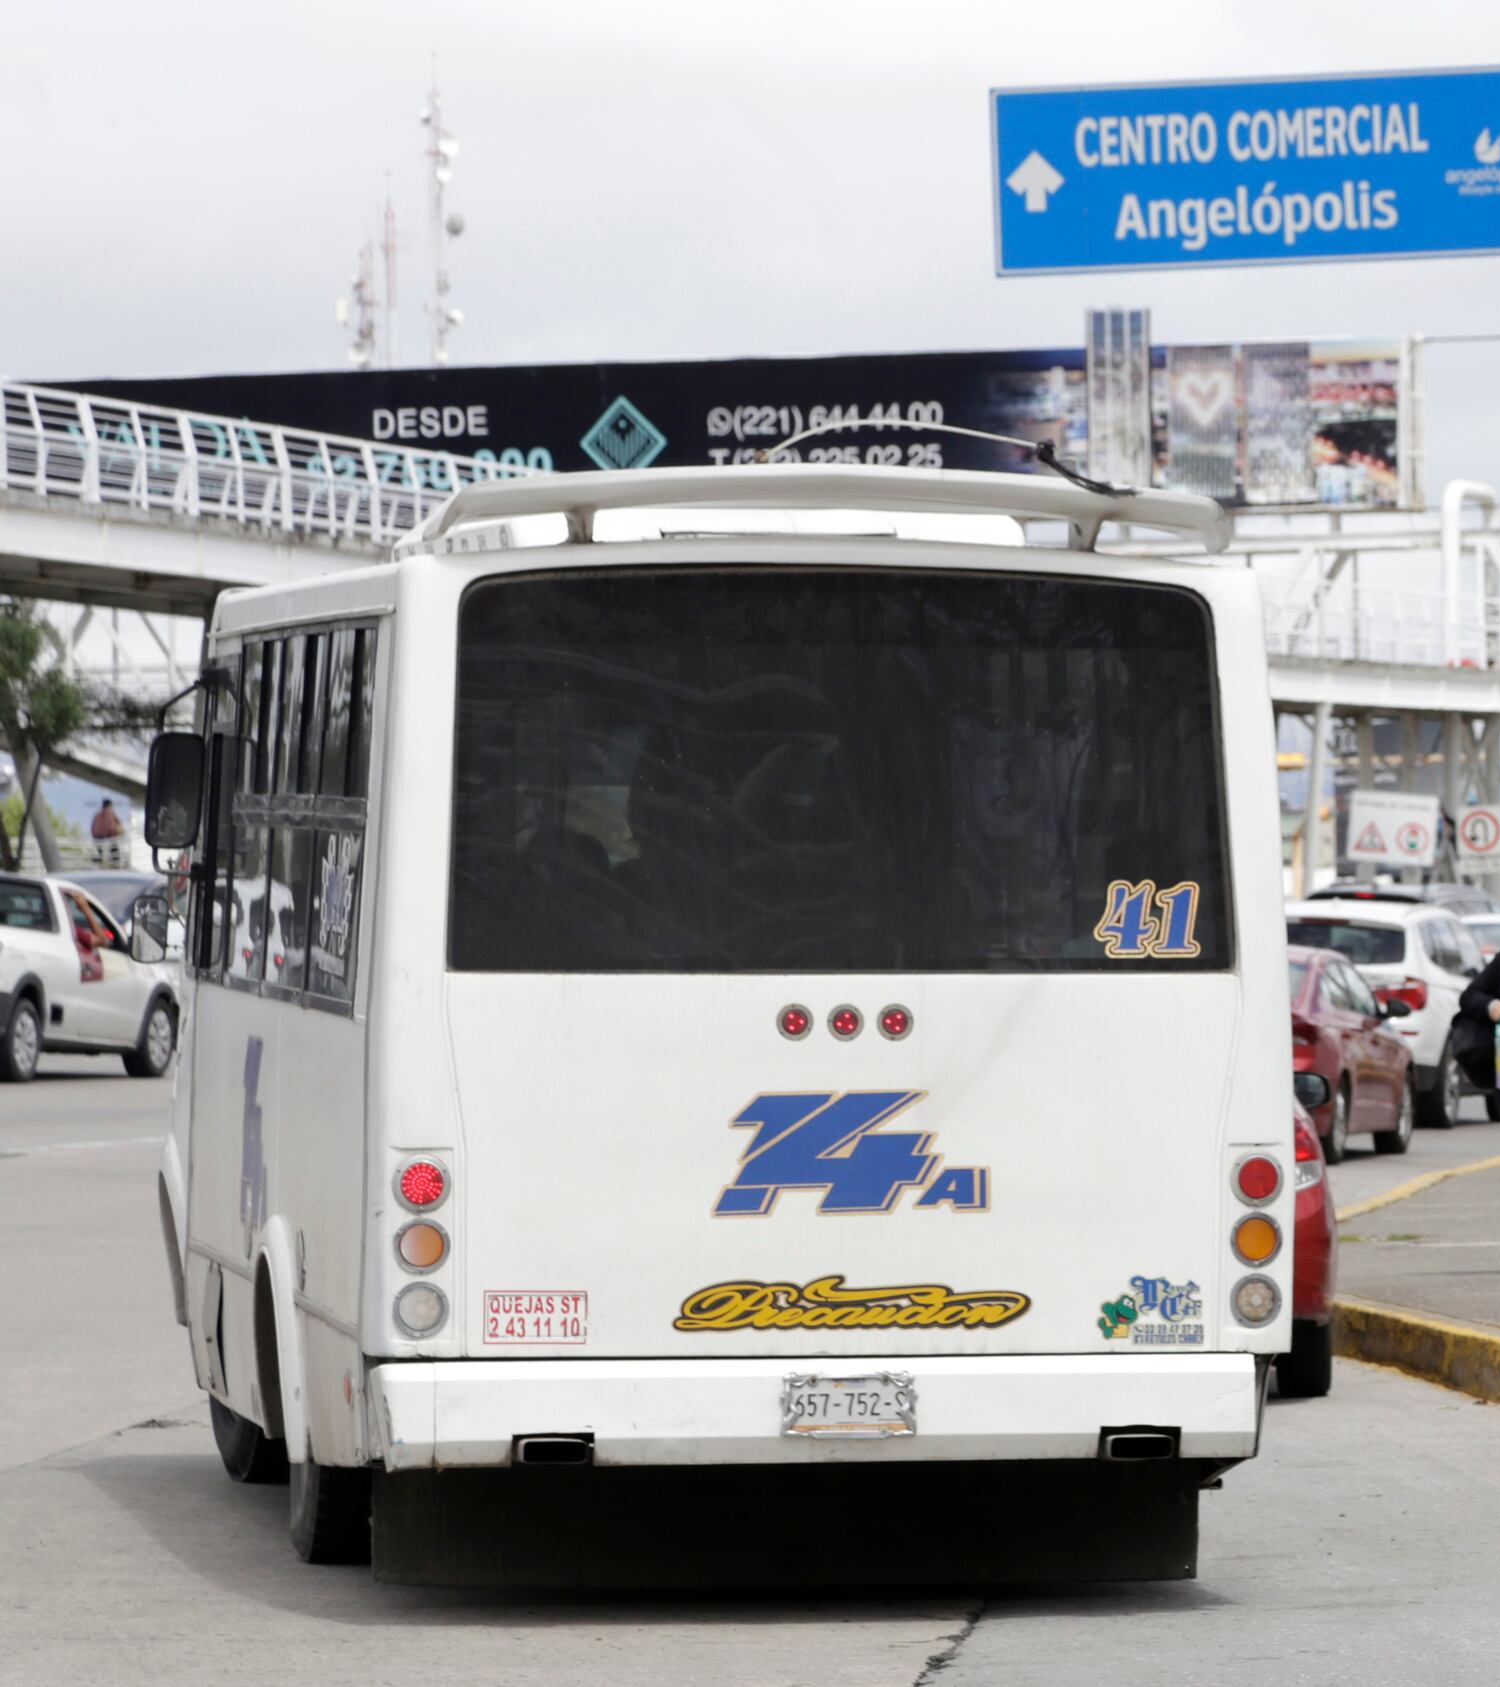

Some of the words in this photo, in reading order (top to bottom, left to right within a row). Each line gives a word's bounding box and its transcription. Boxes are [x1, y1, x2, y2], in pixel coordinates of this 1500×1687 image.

[1074, 111, 1218, 167] CENTRO
[1227, 103, 1430, 162] COMERCIAL
[1115, 181, 1399, 250] Angelópolis
[372, 405, 490, 440] DESDE
[733, 405, 804, 442] (221)
[907, 401, 945, 431] 00
[708, 448, 730, 466] T
[907, 443, 944, 469] 25
[1094, 880, 1201, 959] 41
[490, 1295, 555, 1315] QUEJAS
[561, 1295, 581, 1315] ST
[489, 1317, 499, 1338] 2
[505, 1316, 527, 1338] 43
[533, 1317, 552, 1338] 11
[560, 1317, 580, 1337] 10
